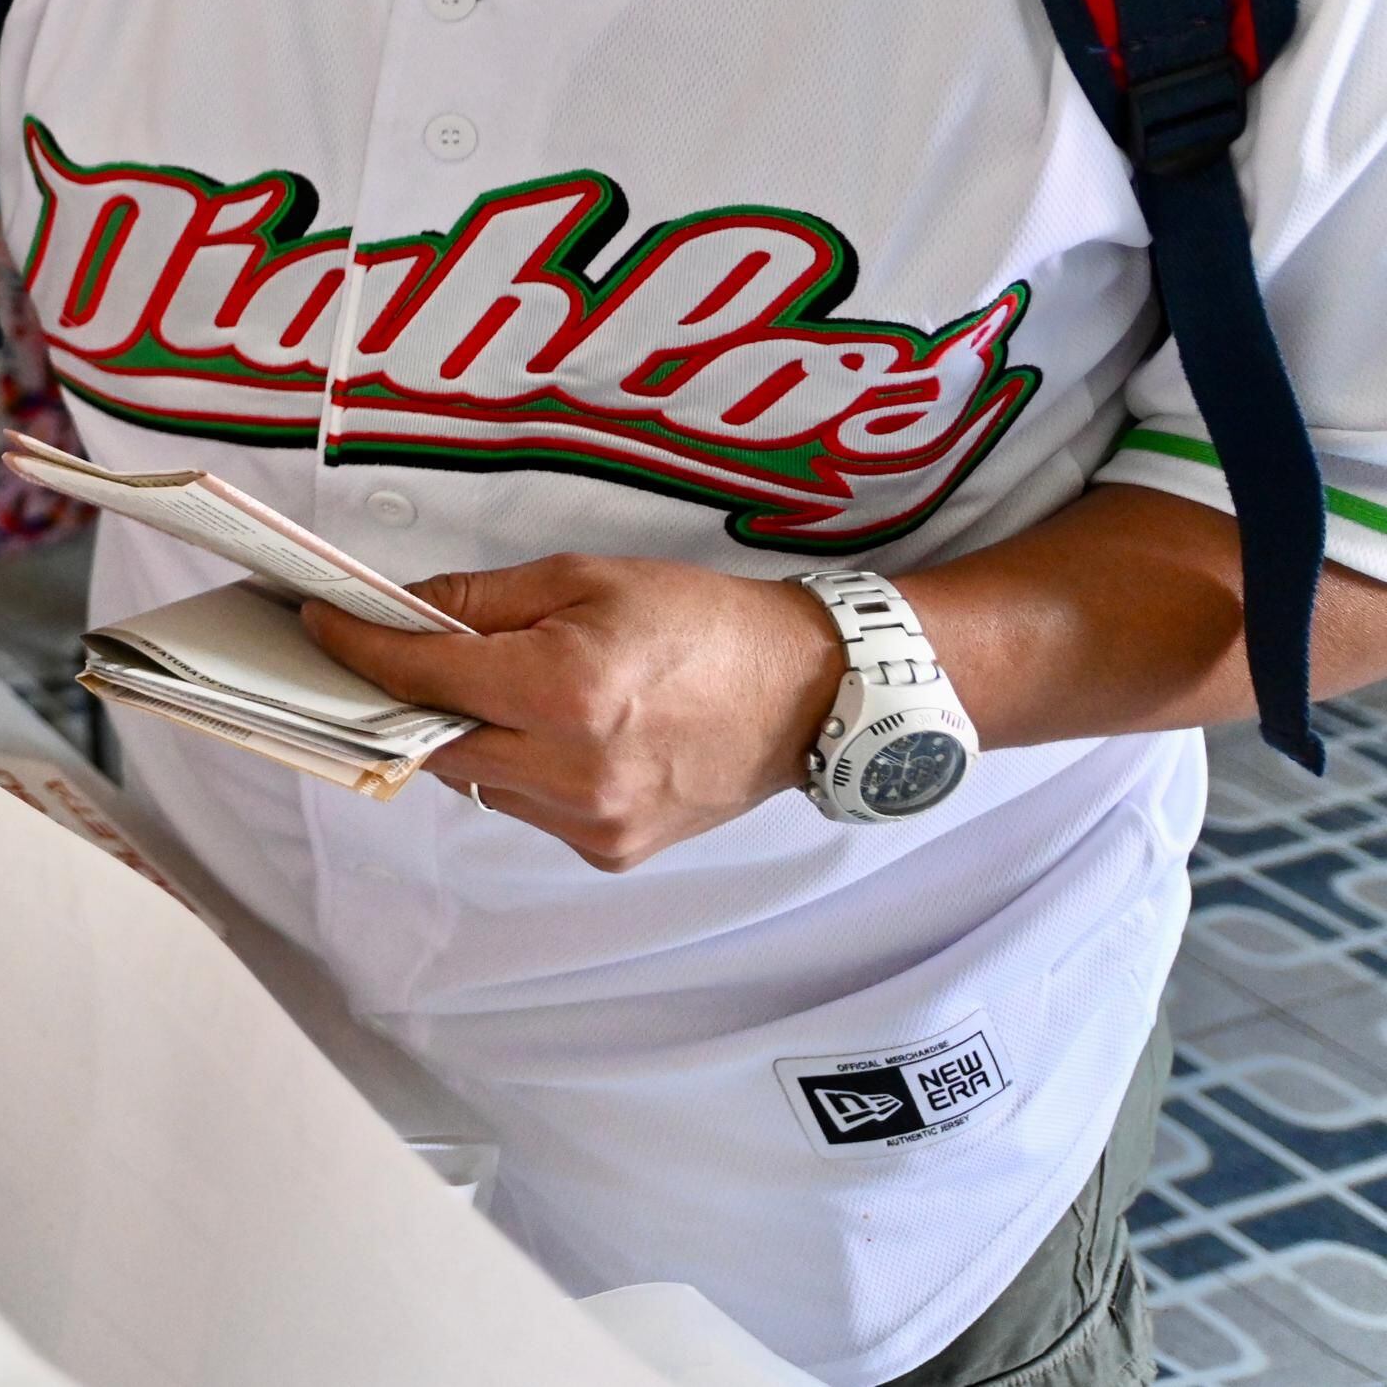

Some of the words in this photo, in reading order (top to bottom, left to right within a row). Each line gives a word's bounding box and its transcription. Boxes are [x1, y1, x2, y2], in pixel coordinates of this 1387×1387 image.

[139, 638, 198, 677] JEFATURA
[836, 1059, 882, 1073] OFFICIAL
[884, 1039, 950, 1065] MERCHANDISE
[917, 1050, 984, 1093] NEW
[926, 1069, 992, 1112] ERA
[885, 1127, 939, 1148] AUTHENTIC
[939, 1114, 971, 1135] JERSEY
